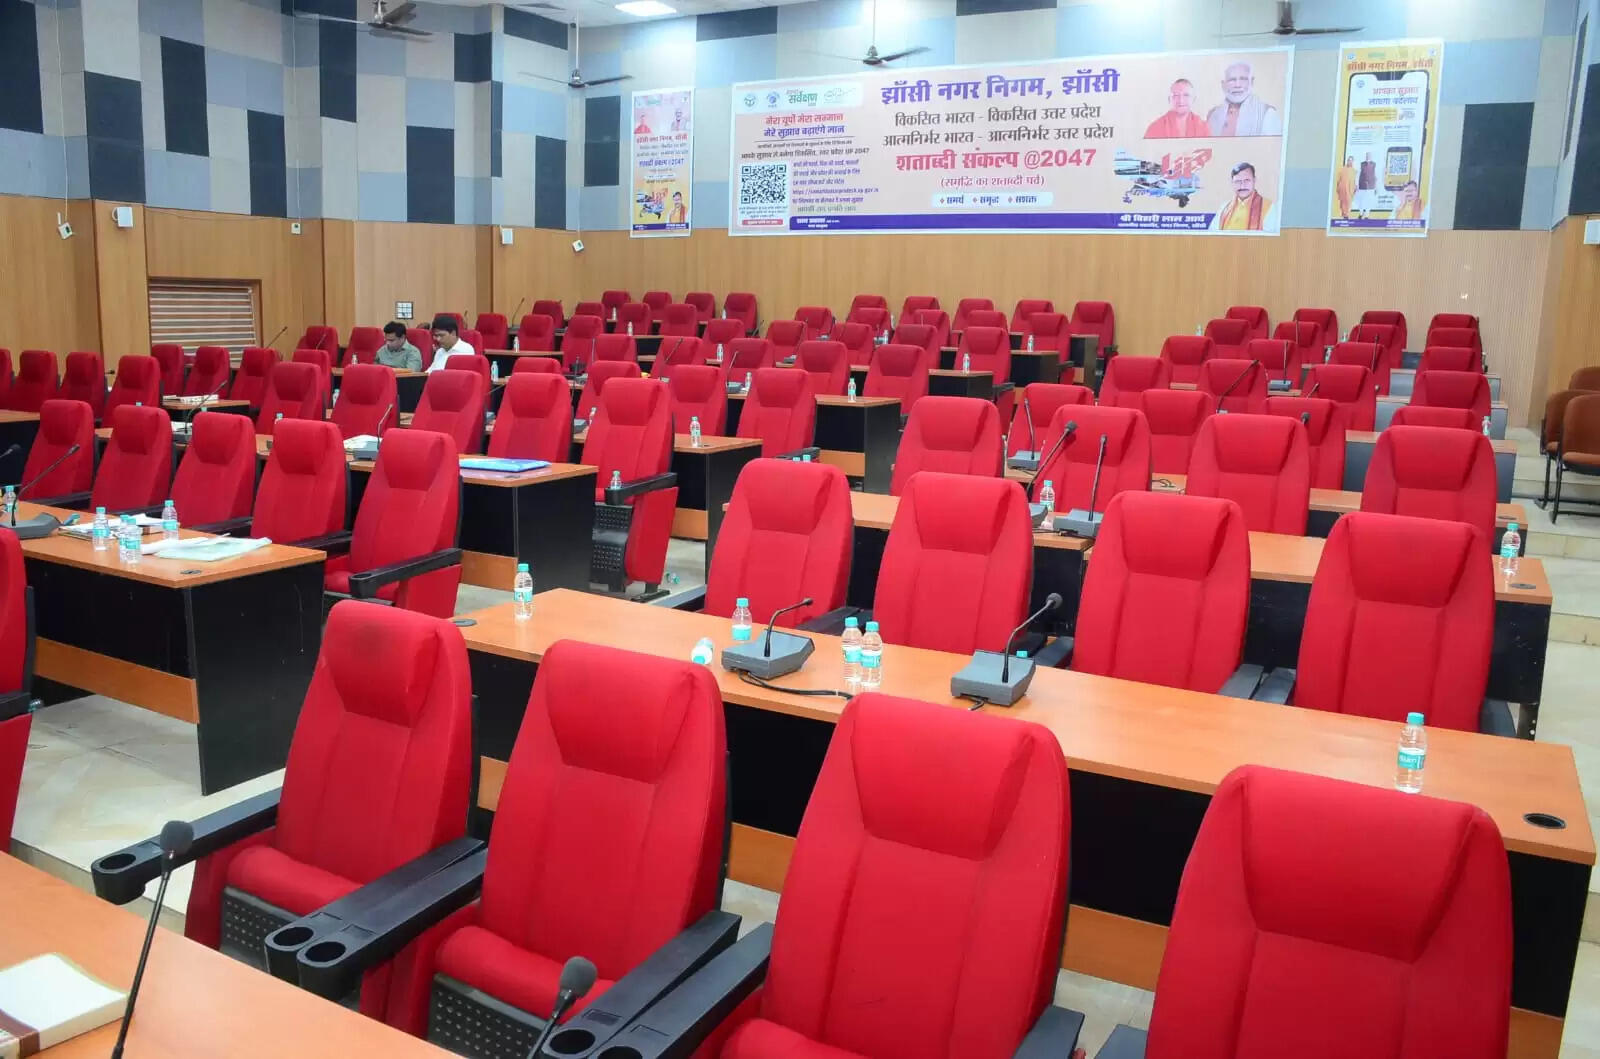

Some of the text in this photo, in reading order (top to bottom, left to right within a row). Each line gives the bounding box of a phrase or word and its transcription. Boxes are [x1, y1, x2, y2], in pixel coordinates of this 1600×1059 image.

[937, 81, 981, 100] नगर
[986, 75, 1052, 99] निगम,
[798, 113, 812, 123] मेरा
[895, 111, 940, 126] विकसित
[945, 112, 974, 124] भारत
[988, 107, 1037, 122] विकसित
[1041, 108, 1066, 120] उत्तर
[1070, 102, 1101, 119] प्रदेश
[827, 125, 845, 134] मान
[883, 129, 940, 146] आत्मनिर्भर
[944, 132, 974, 143] भारत
[988, 125, 1050, 142] आत्मनिर्भर
[1054, 128, 1079, 140] उत्तर
[1083, 123, 1114, 139] प्रदेश
[896, 147, 1097, 171] शताब्दी संकल्प @2047
[975, 177, 988, 186] का
[991, 175, 1023, 186] शताब्दी
[946, 195, 964, 204] समर्थ
